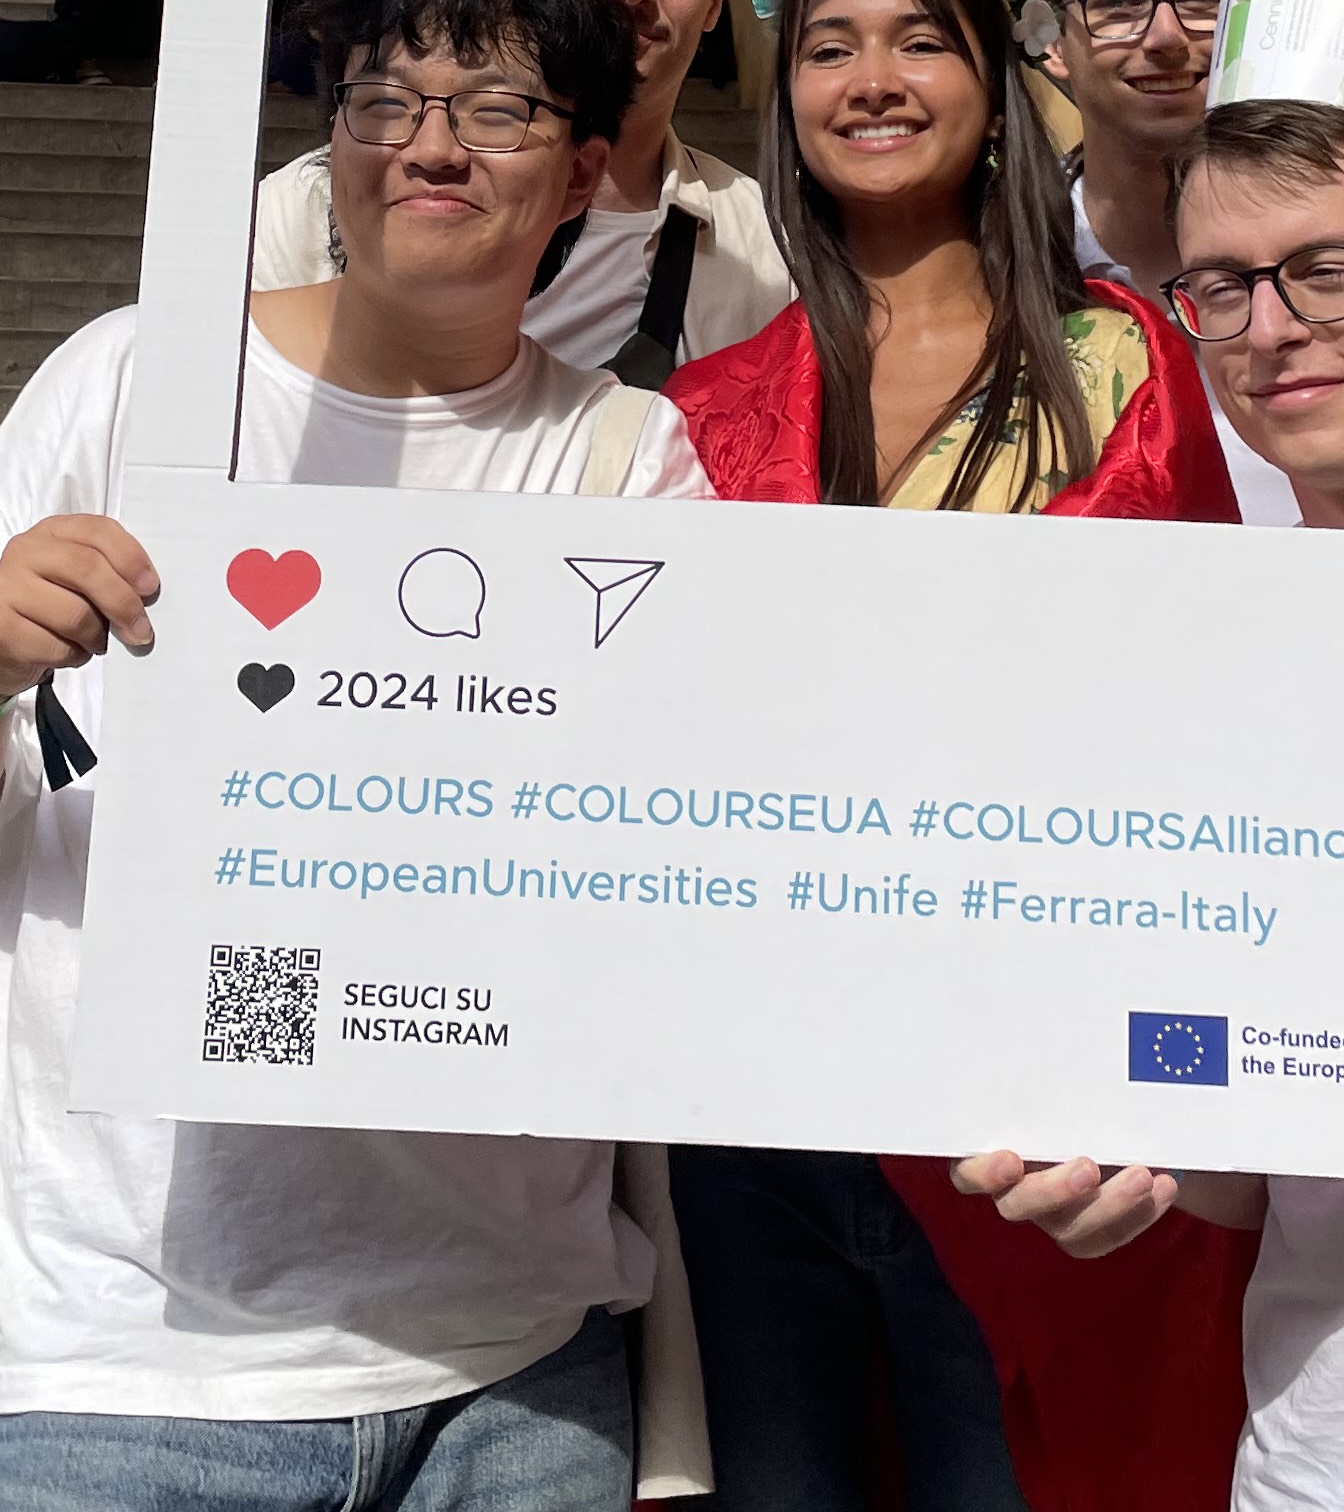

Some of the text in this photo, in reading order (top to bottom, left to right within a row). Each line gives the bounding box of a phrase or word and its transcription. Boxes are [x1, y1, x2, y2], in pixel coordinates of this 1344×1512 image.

[316, 670, 558, 716] 2024 likes
[219, 769, 494, 818] #COLOURS
[510, 781, 892, 834] #COLOURSEUA
[213, 847, 1278, 947] #EuropeanUniversities #Unife #Ferrara-Italy
[343, 982, 492, 1012] SEGUCI SU
[341, 1016, 509, 1048] INSTAGRAM
[1241, 1054, 1276, 1076] the
